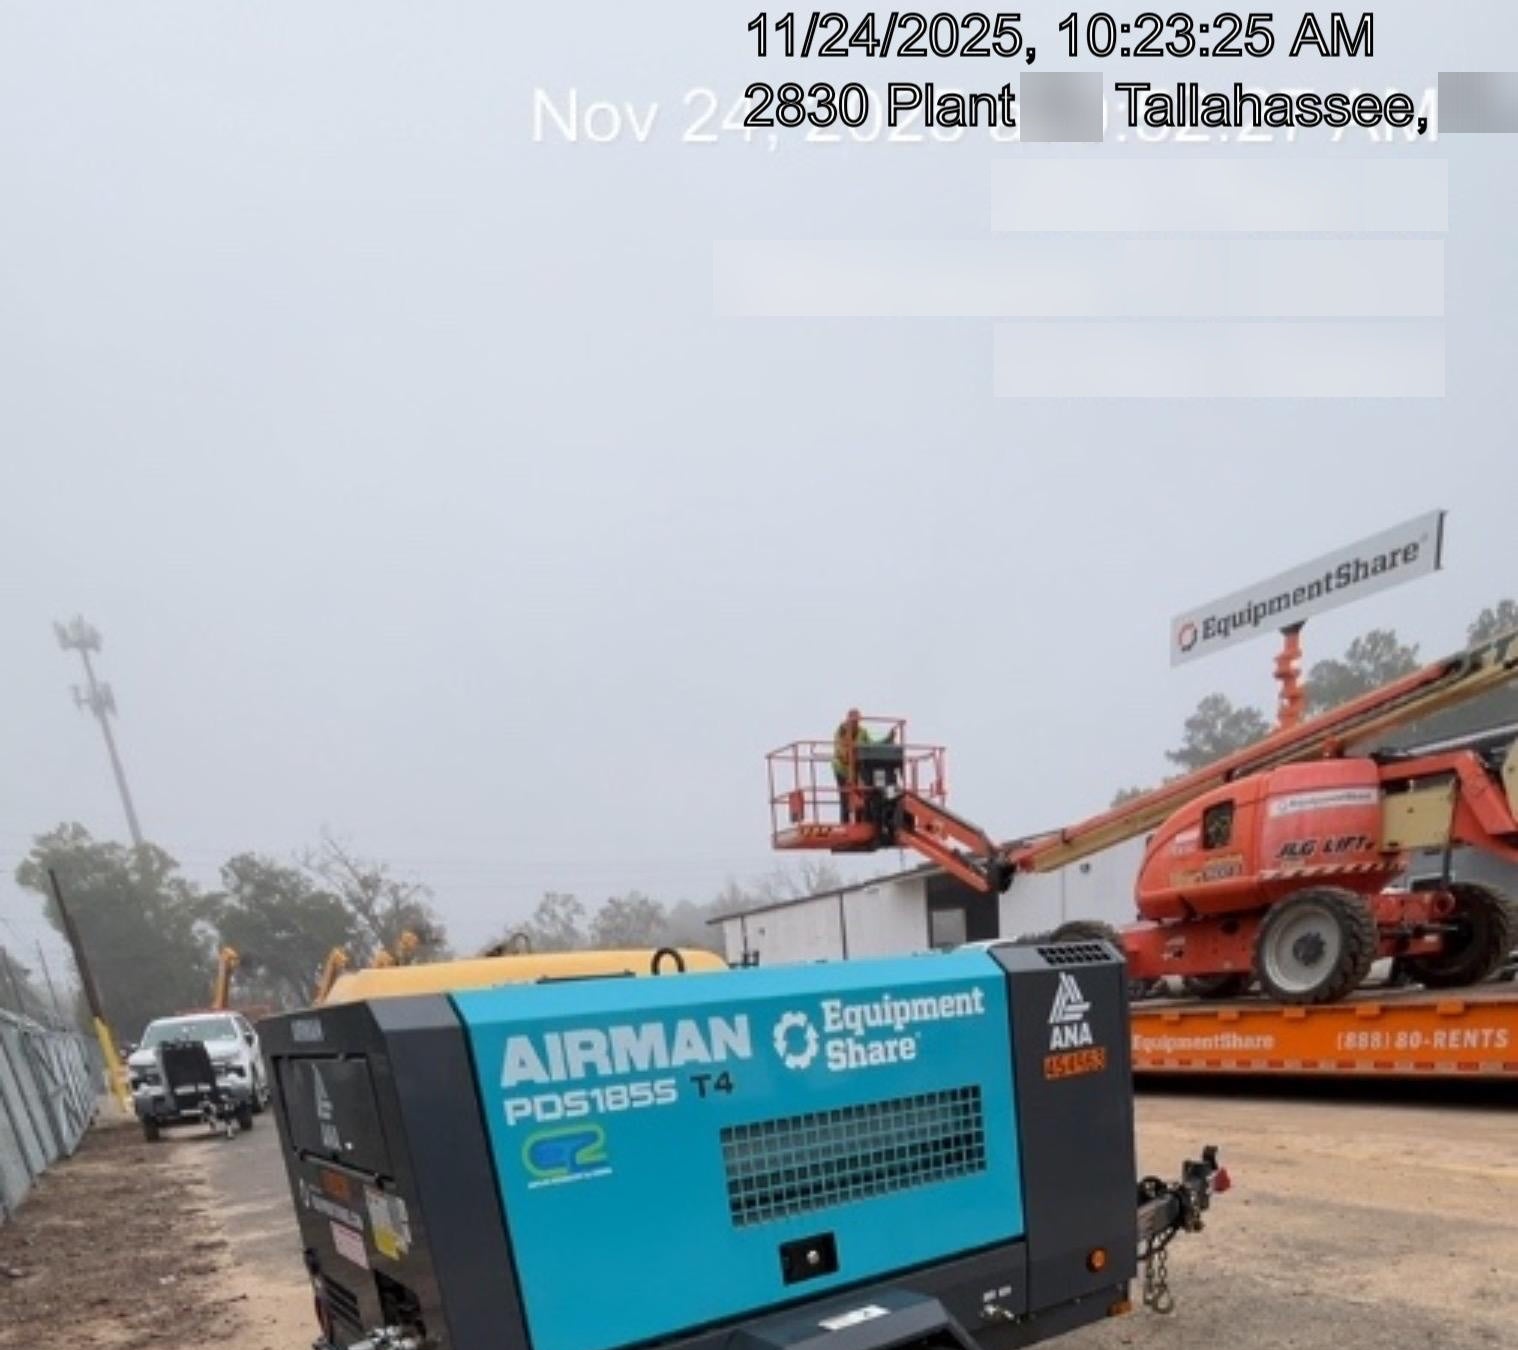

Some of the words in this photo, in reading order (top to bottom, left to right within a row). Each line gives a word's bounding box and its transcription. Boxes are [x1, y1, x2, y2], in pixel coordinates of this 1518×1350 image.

[1202, 541, 1420, 640] EquipmentShare
[820, 986, 985, 1036] Equipment
[501, 1014, 752, 1088] AIRMAN
[825, 1036, 917, 1072] Share
[1049, 1021, 1094, 1051] ANA
[1131, 1032, 1275, 1054] EquipmentShare
[1336, 1030, 1390, 1051] (888)
[1394, 1028, 1510, 1050] 80-RENTS
[503, 1078, 679, 1127] PDS185S
[690, 1070, 734, 1099] T4
